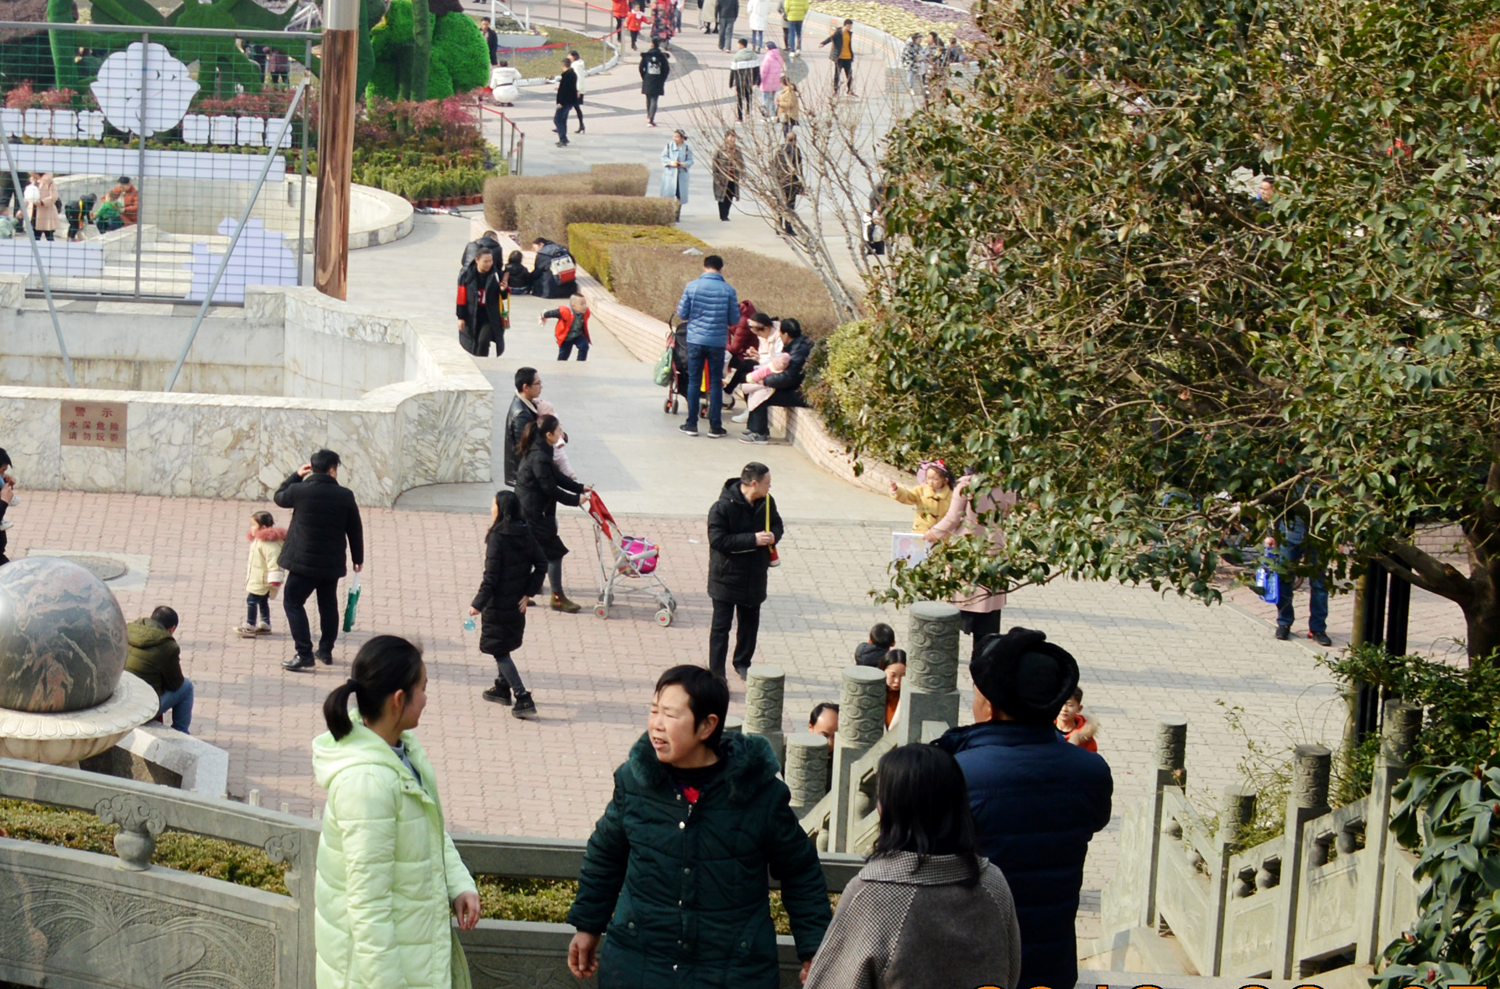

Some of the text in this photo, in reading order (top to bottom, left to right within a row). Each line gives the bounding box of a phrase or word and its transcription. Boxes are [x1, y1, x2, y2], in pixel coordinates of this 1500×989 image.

[75, 406, 113, 418] 警示
[68, 420, 119, 431] 水深危险
